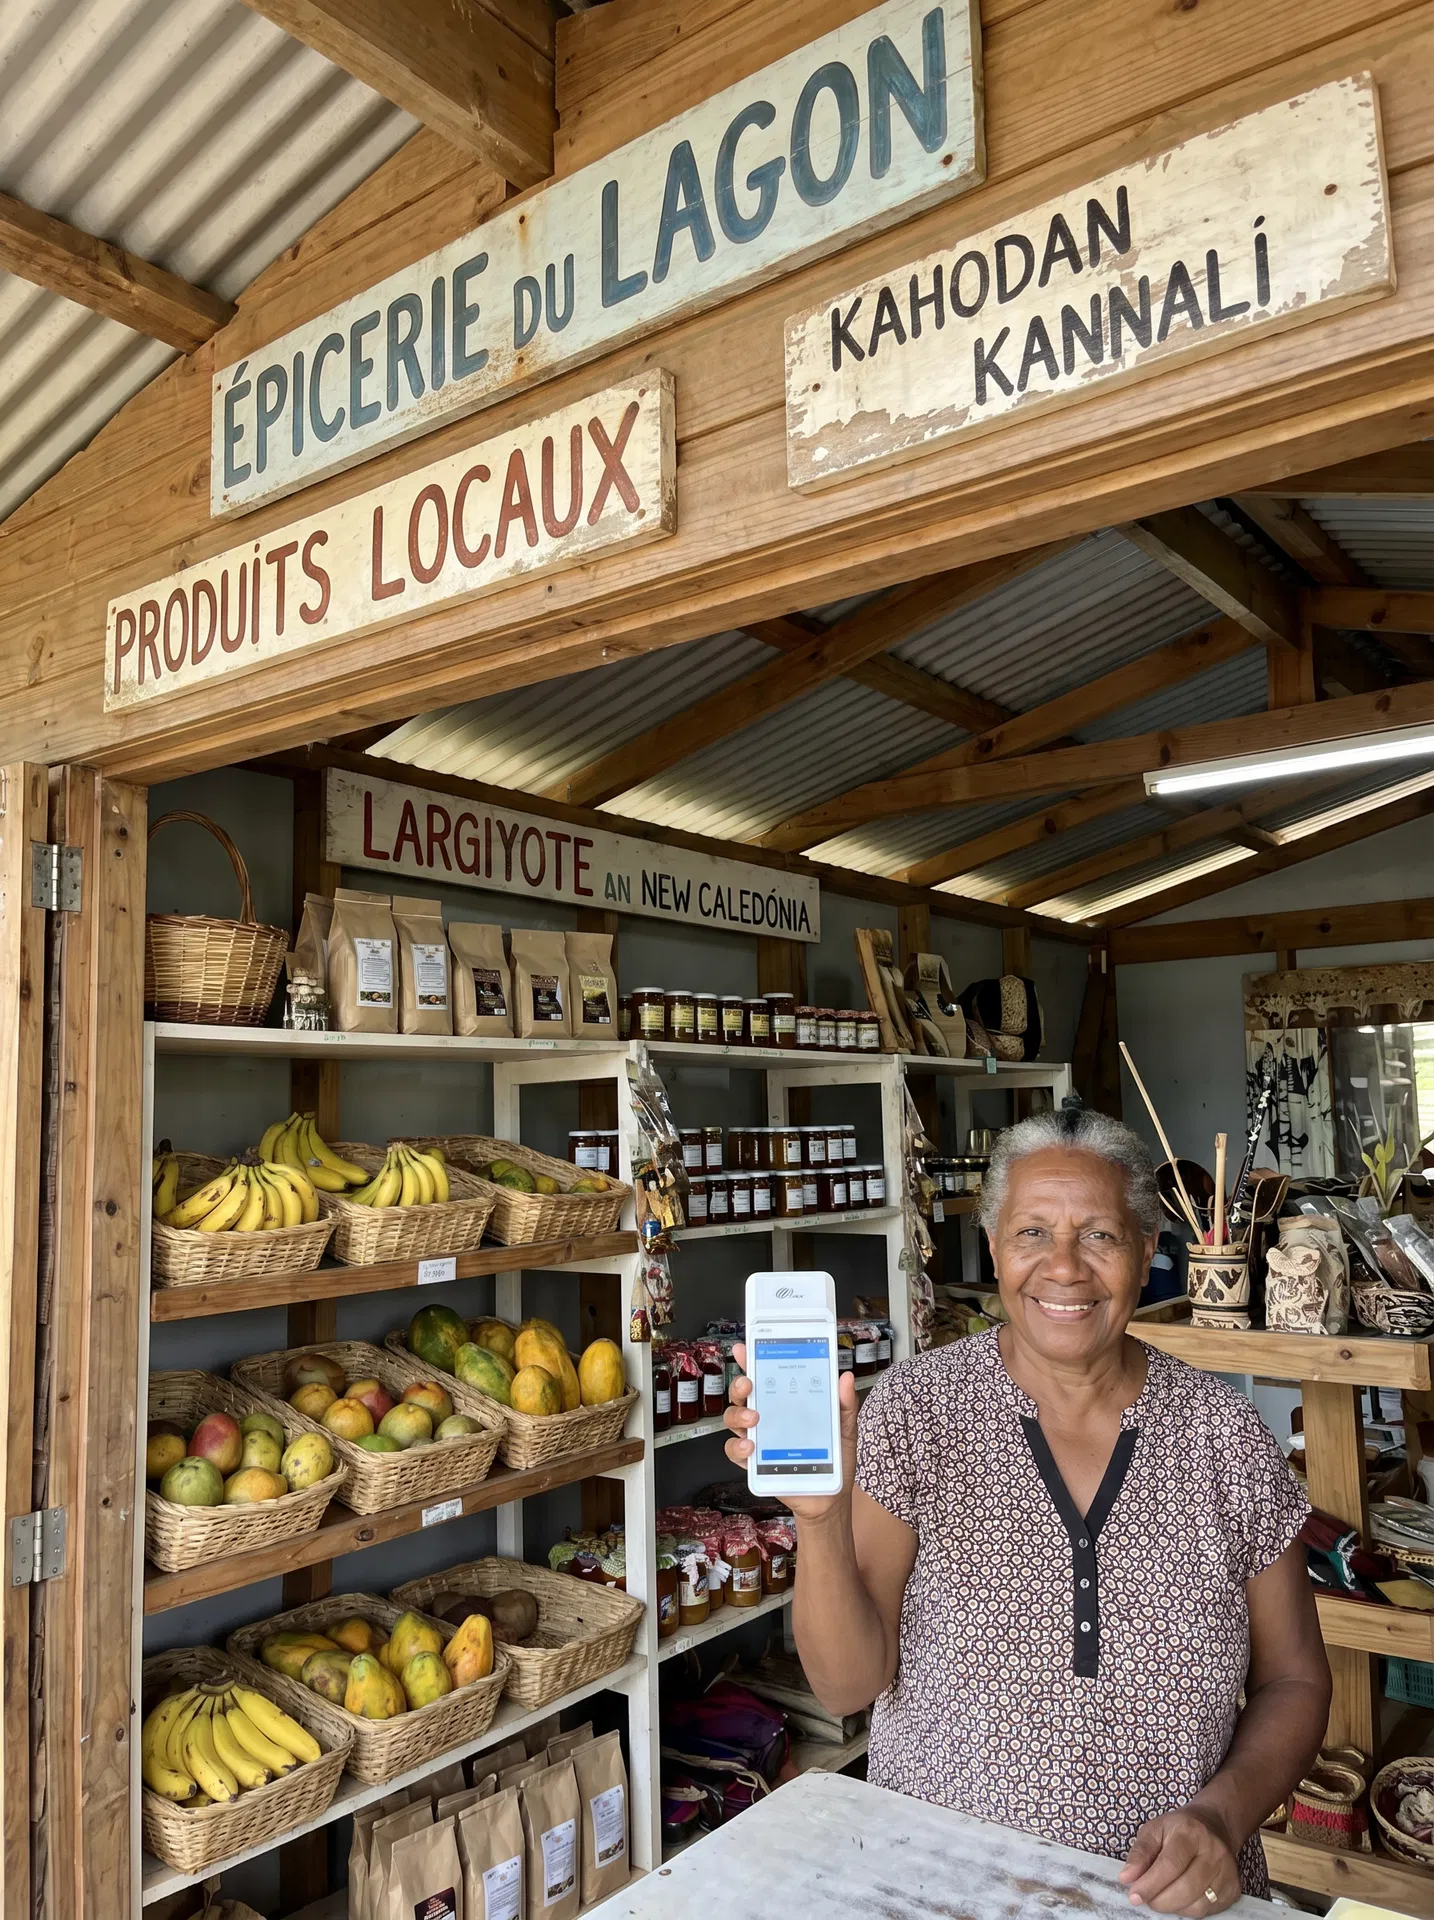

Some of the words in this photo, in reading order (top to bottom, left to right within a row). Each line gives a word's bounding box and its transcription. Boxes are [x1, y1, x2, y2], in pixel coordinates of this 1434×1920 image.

[223, 252, 489, 489] ÉPICERIE
[513, 253, 575, 350] DU
[601, 6, 948, 309] LAGON
[831, 185, 1132, 372] KAHODAN
[371, 401, 640, 602] LOCAUX
[363, 790, 594, 897] LARGIYOTE
[604, 871, 631, 904] AN
[641, 869, 691, 914] NEW
[698, 882, 811, 934] CALEDÓNIA
